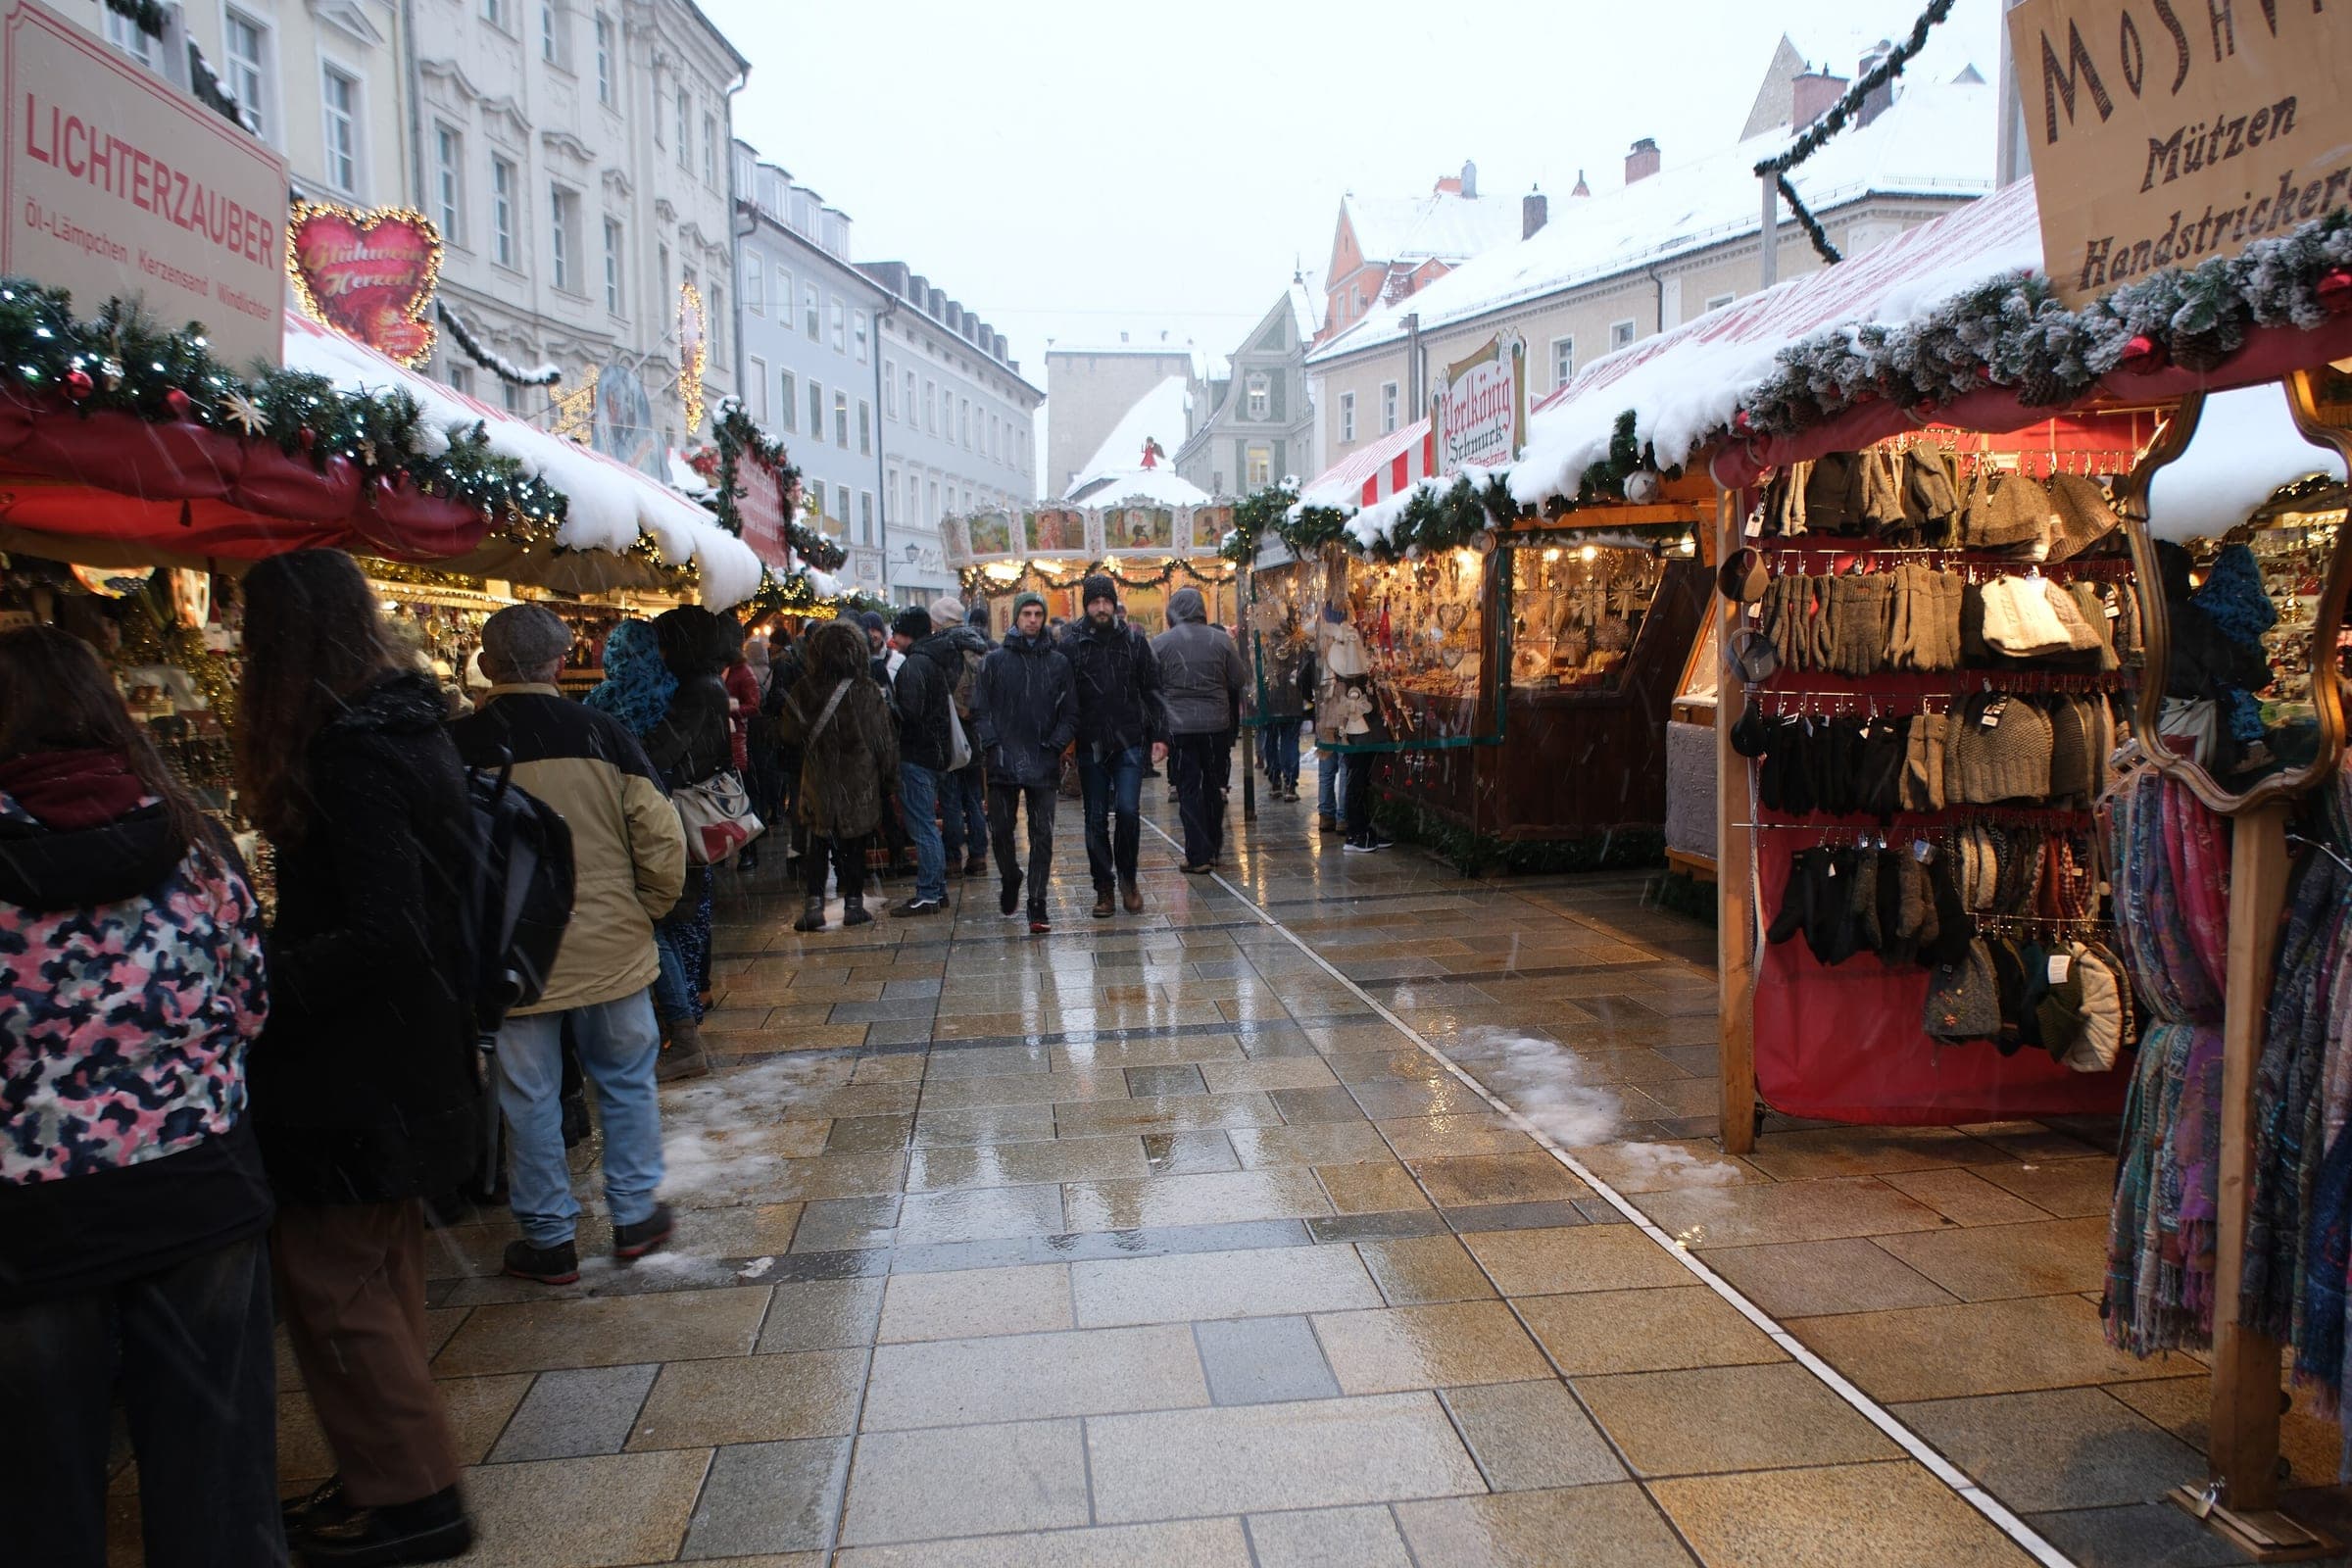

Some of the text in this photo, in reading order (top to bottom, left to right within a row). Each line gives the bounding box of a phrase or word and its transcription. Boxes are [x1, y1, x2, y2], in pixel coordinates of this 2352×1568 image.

[26, 92, 274, 270] LICHTERZAUBER
[2139, 96, 2297, 194] Mützen
[24, 196, 128, 266] Öl-Lämpchen
[2078, 166, 2352, 292] Handstricker
[1448, 417, 1503, 466] Schmuck
